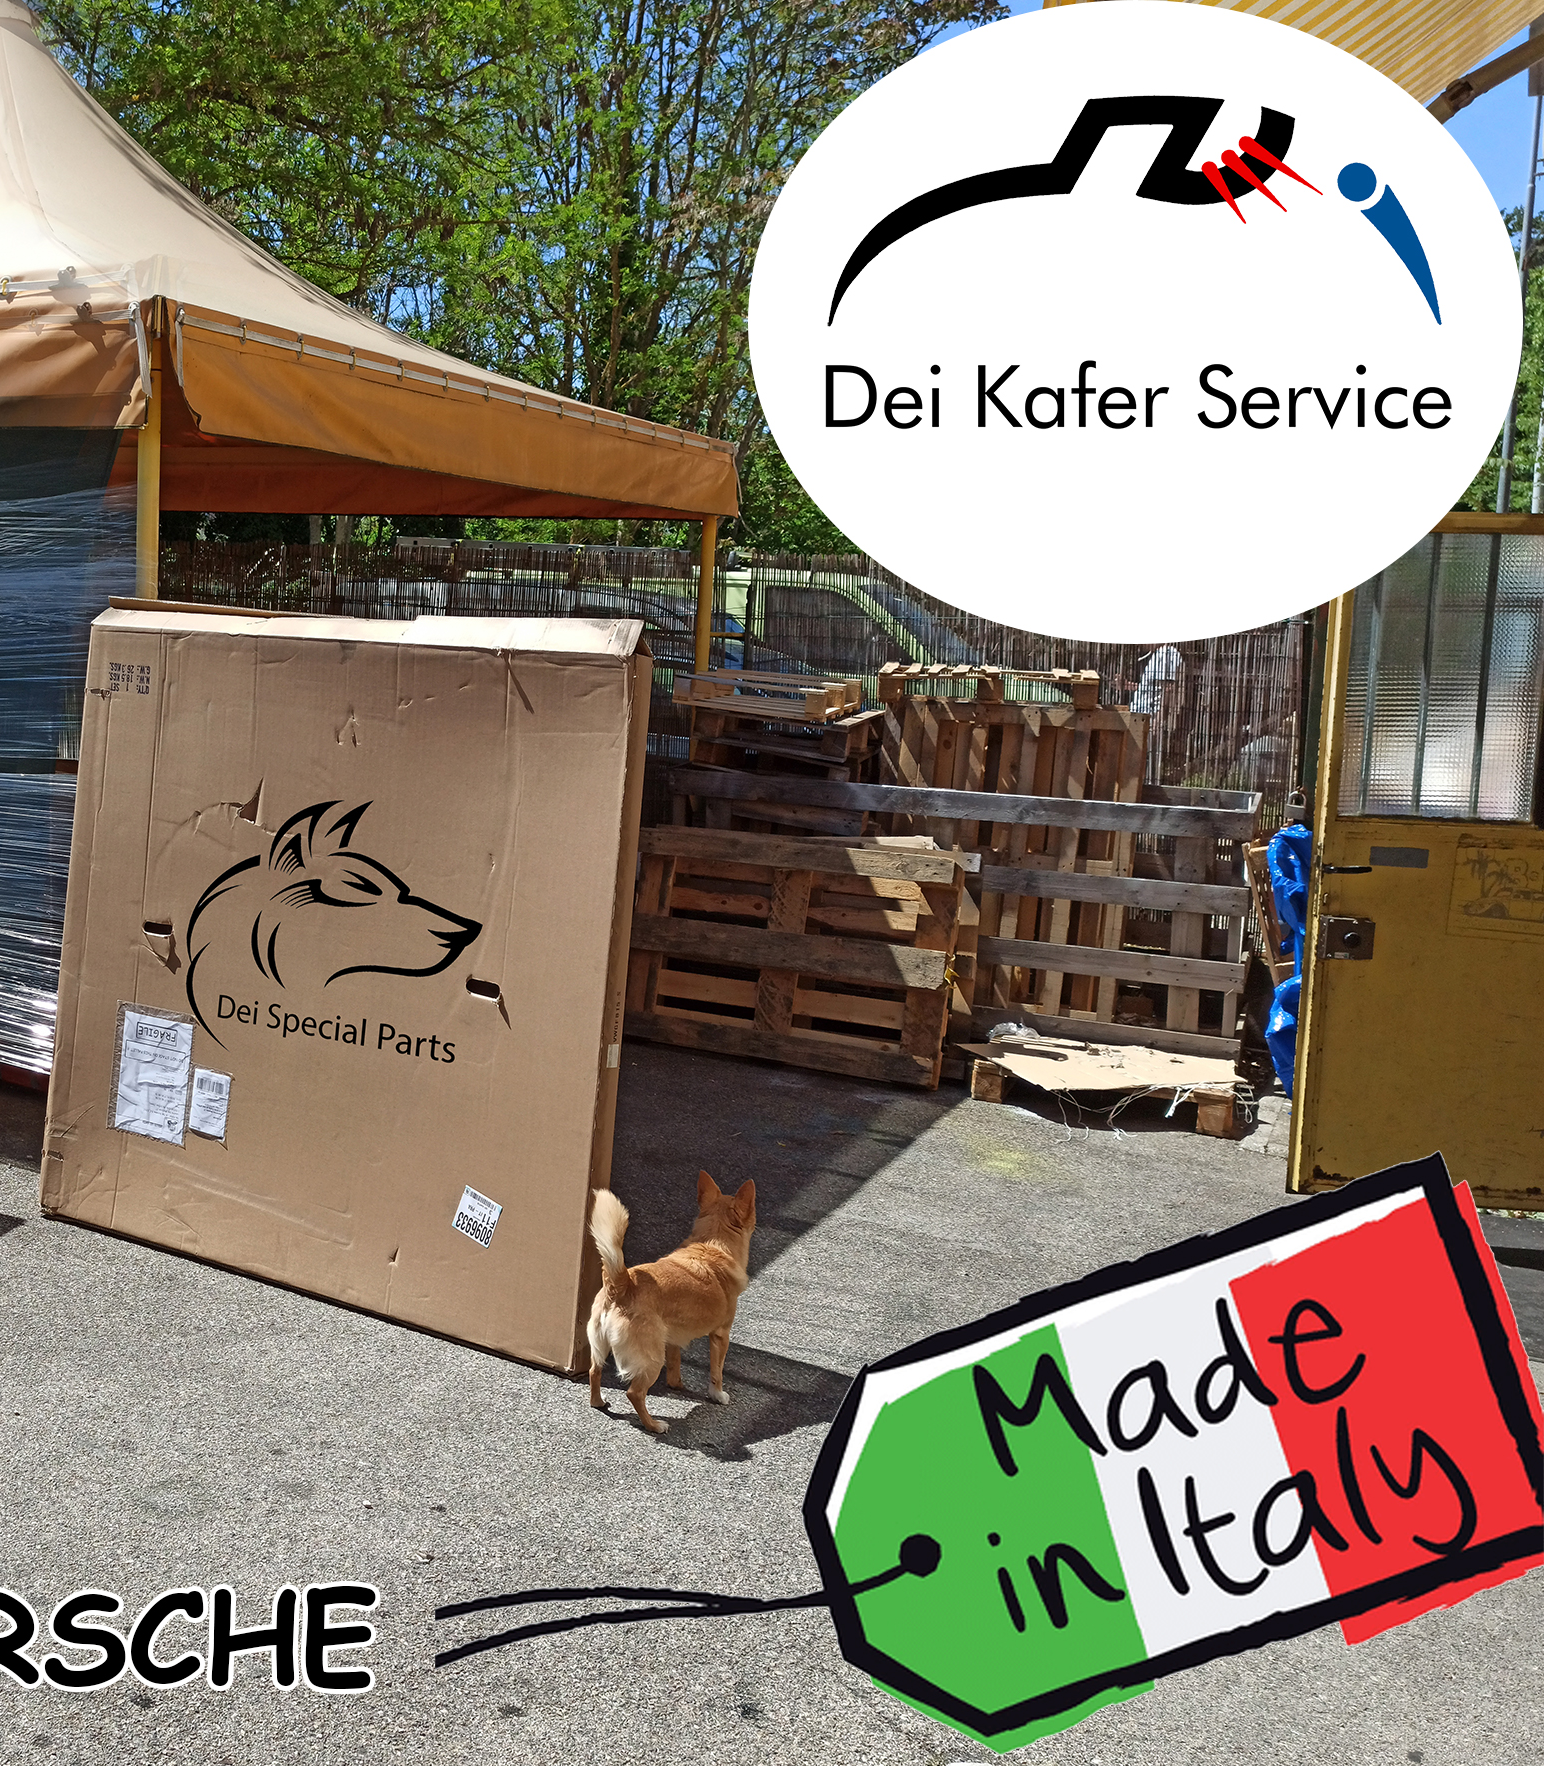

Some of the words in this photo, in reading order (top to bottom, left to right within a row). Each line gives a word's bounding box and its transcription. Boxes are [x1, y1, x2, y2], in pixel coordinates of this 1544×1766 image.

[138, 1025, 177, 1043] FRAGILE
[217, 994, 259, 1025] Dei
[266, 1003, 367, 1047] Special
[377, 1023, 456, 1064] Parts
[456, 1211, 492, 1245] 8096933
